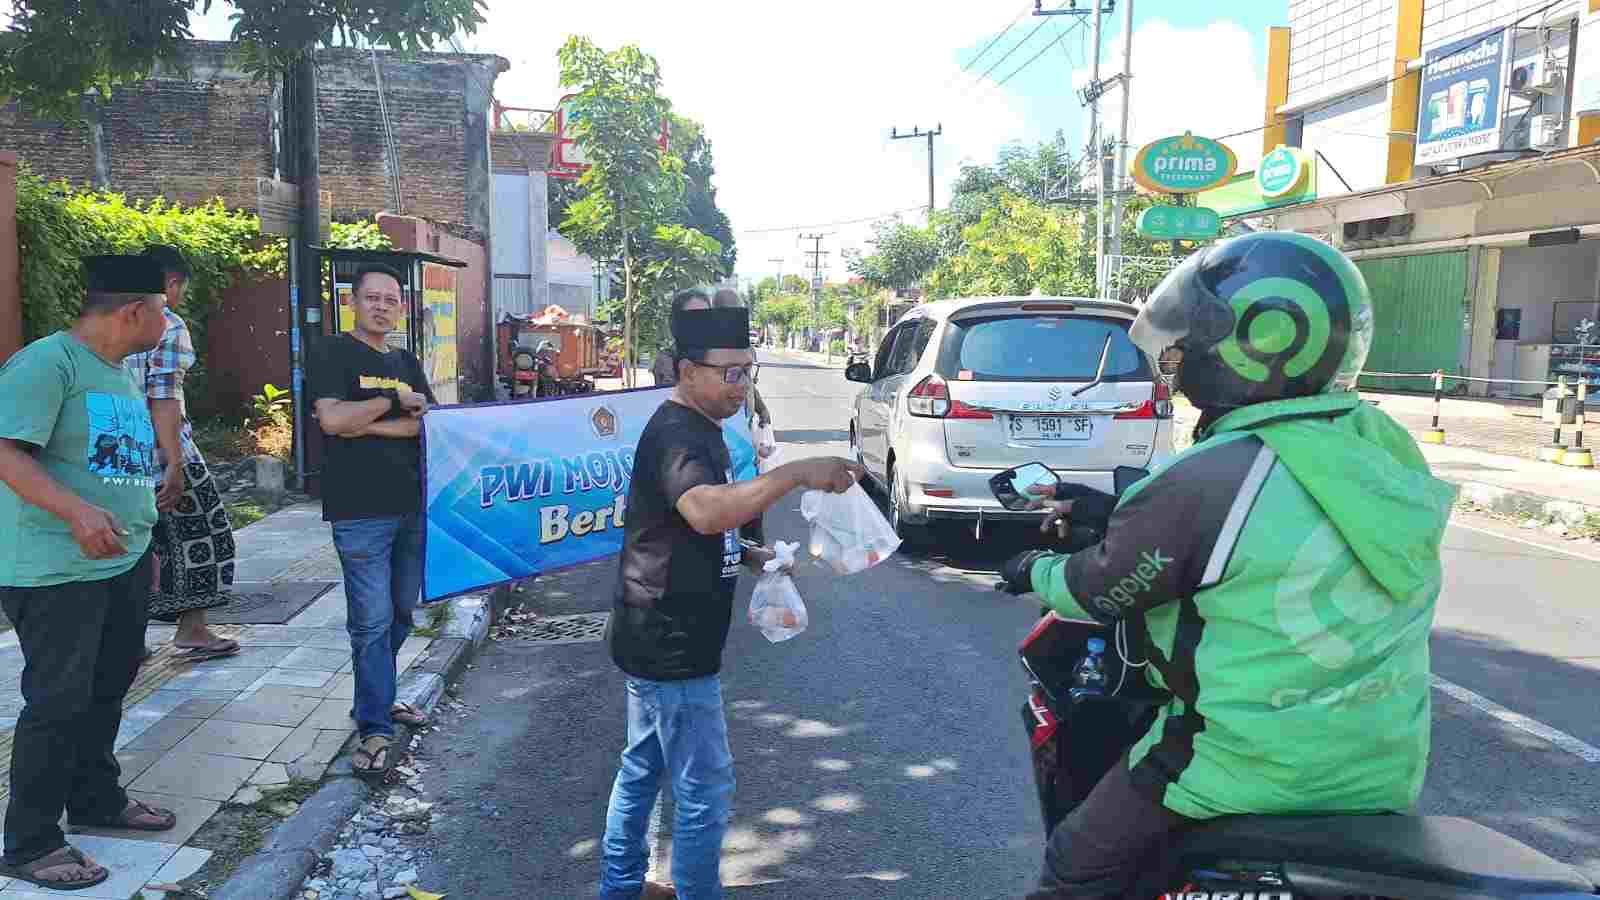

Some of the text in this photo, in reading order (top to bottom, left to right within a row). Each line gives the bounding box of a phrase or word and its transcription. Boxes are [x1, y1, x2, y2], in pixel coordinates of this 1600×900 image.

[1154, 156, 1217, 176] prima
[1032, 417, 1062, 432] 1591
[479, 462, 553, 508] PWI
